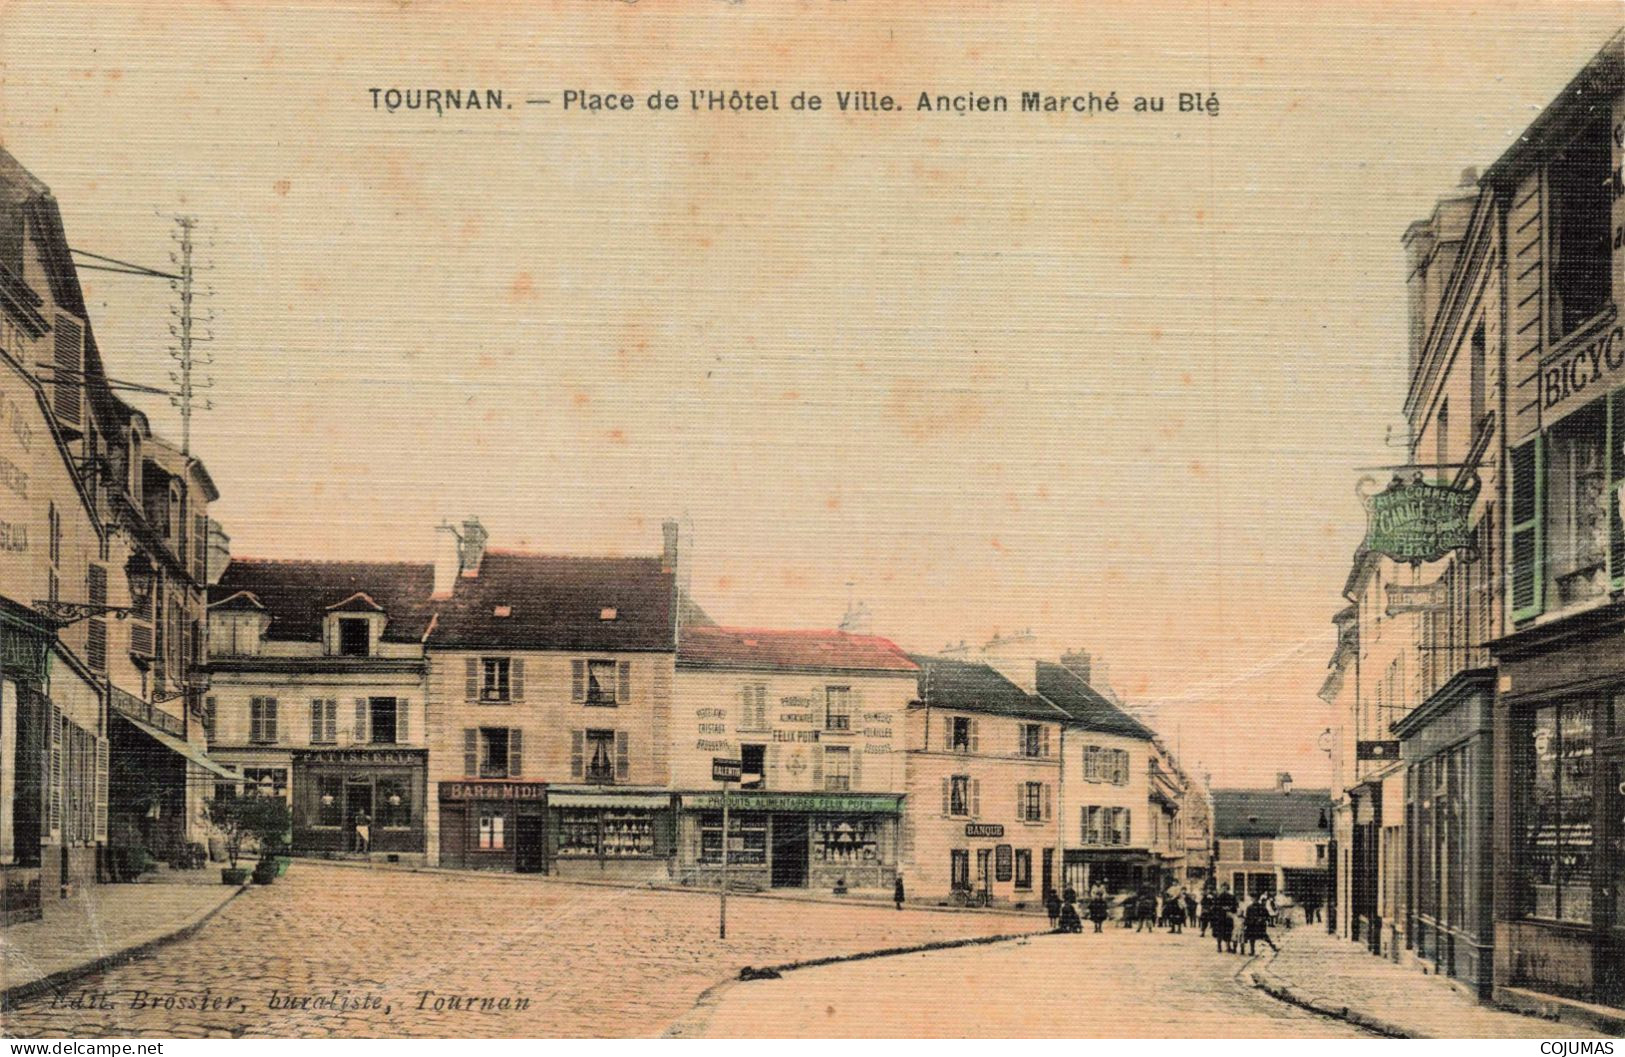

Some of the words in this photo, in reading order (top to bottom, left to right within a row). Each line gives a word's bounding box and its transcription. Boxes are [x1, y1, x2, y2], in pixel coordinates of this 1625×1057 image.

[1404, 486, 1472, 508] COMMERCE
[1379, 500, 1427, 535] GARAGE
[772, 730, 796, 742] FELIX
[451, 784, 484, 799] BAR
[503, 783, 538, 799] MIDI
[967, 826, 1003, 837] BANQUE
